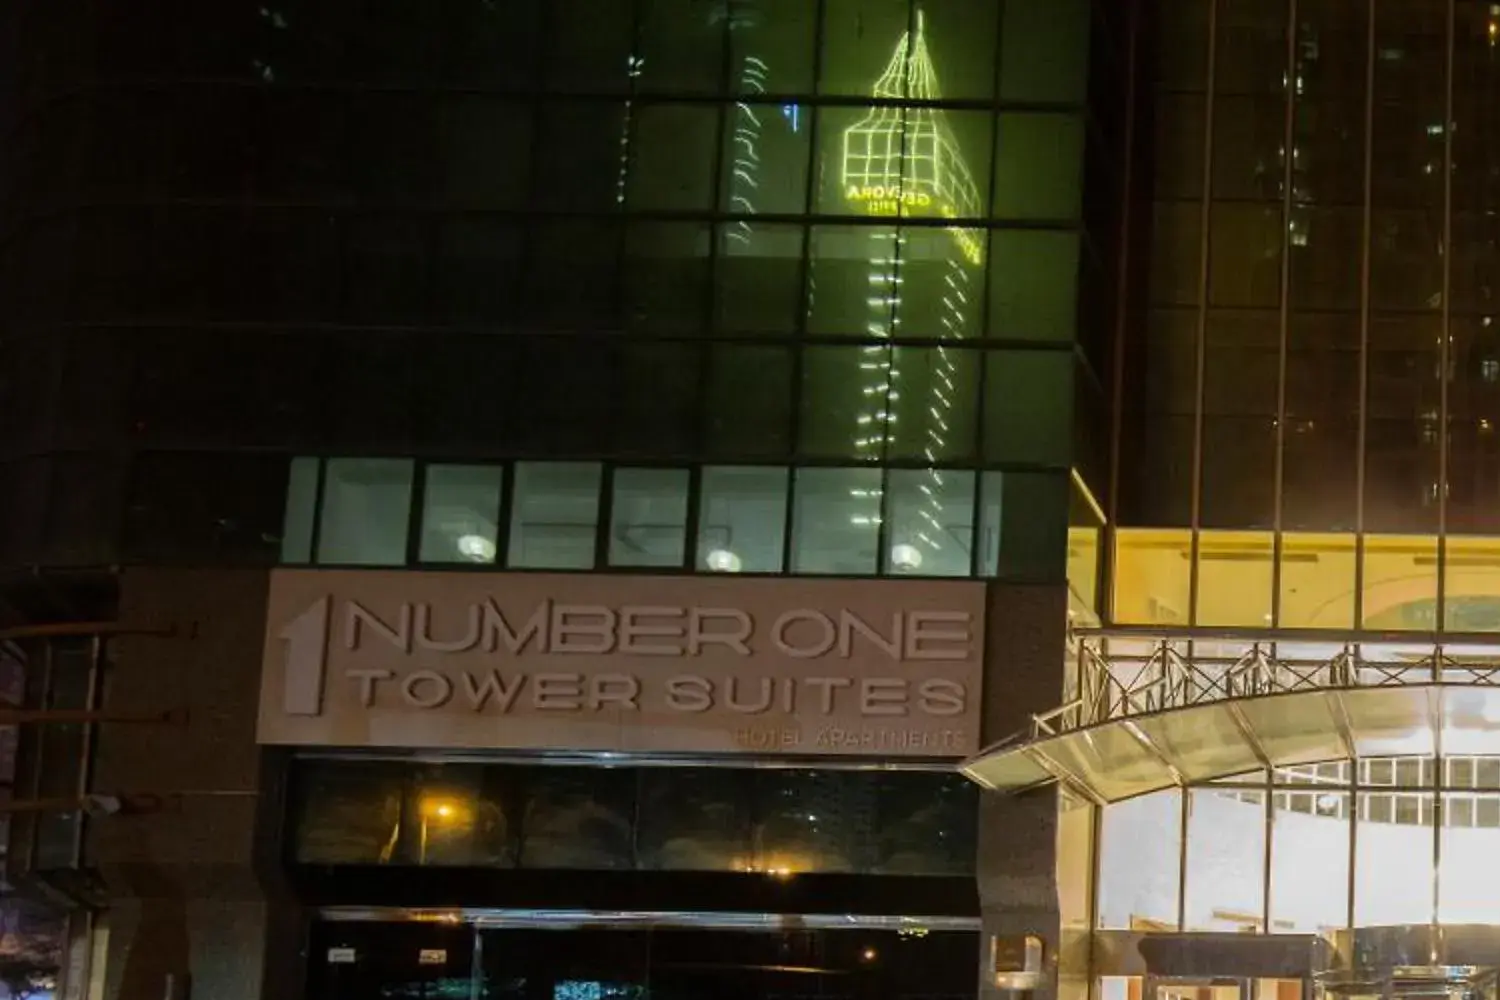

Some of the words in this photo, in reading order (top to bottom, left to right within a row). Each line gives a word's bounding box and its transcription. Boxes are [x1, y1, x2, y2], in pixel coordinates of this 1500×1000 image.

[278, 594, 333, 716] 1
[345, 598, 753, 656] NUMBER
[769, 608, 971, 662] ONE
[345, 668, 639, 711] TOWER
[665, 673, 965, 715] SUITES
[735, 725, 801, 748] HOTEL
[816, 724, 967, 750] APARTMENTS
